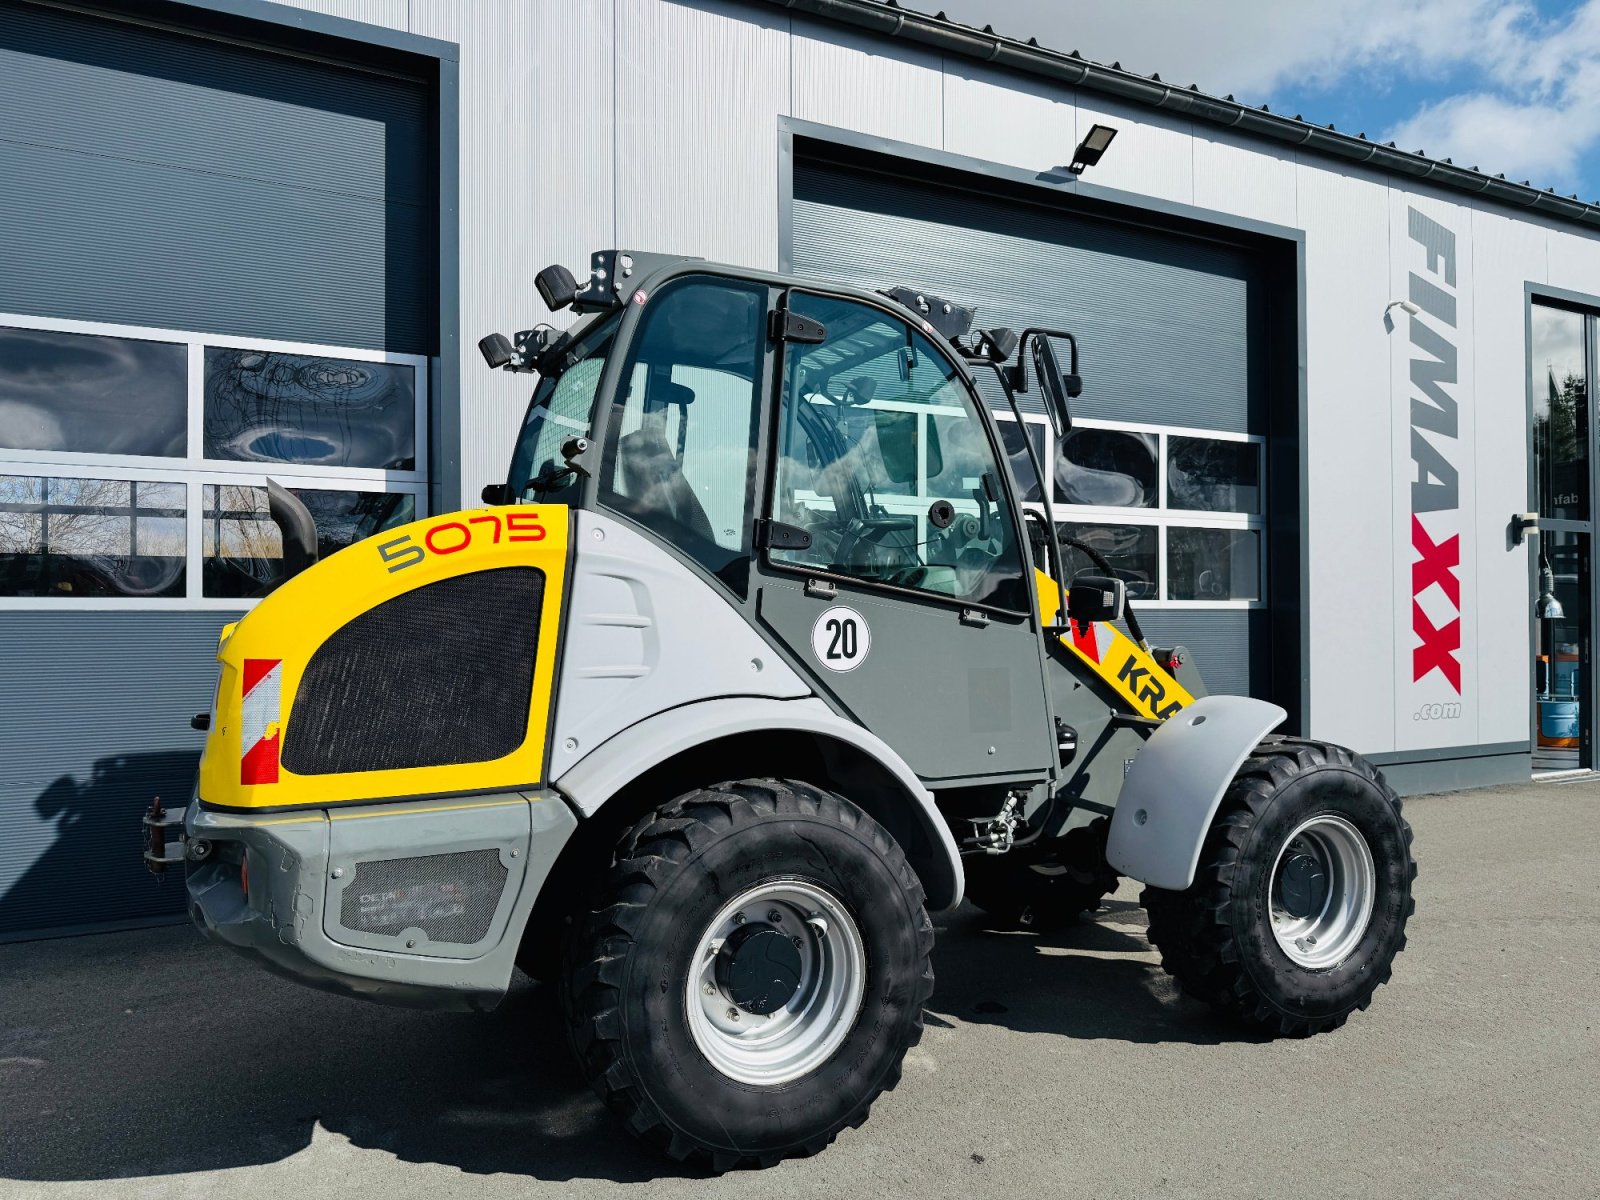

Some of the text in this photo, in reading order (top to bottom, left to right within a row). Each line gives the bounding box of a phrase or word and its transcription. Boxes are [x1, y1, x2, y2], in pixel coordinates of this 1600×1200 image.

[1408, 205, 1461, 696] FIMAXX
[377, 513, 546, 573] 5075
[826, 618, 858, 660] 20
[1413, 702, 1461, 720] .com
